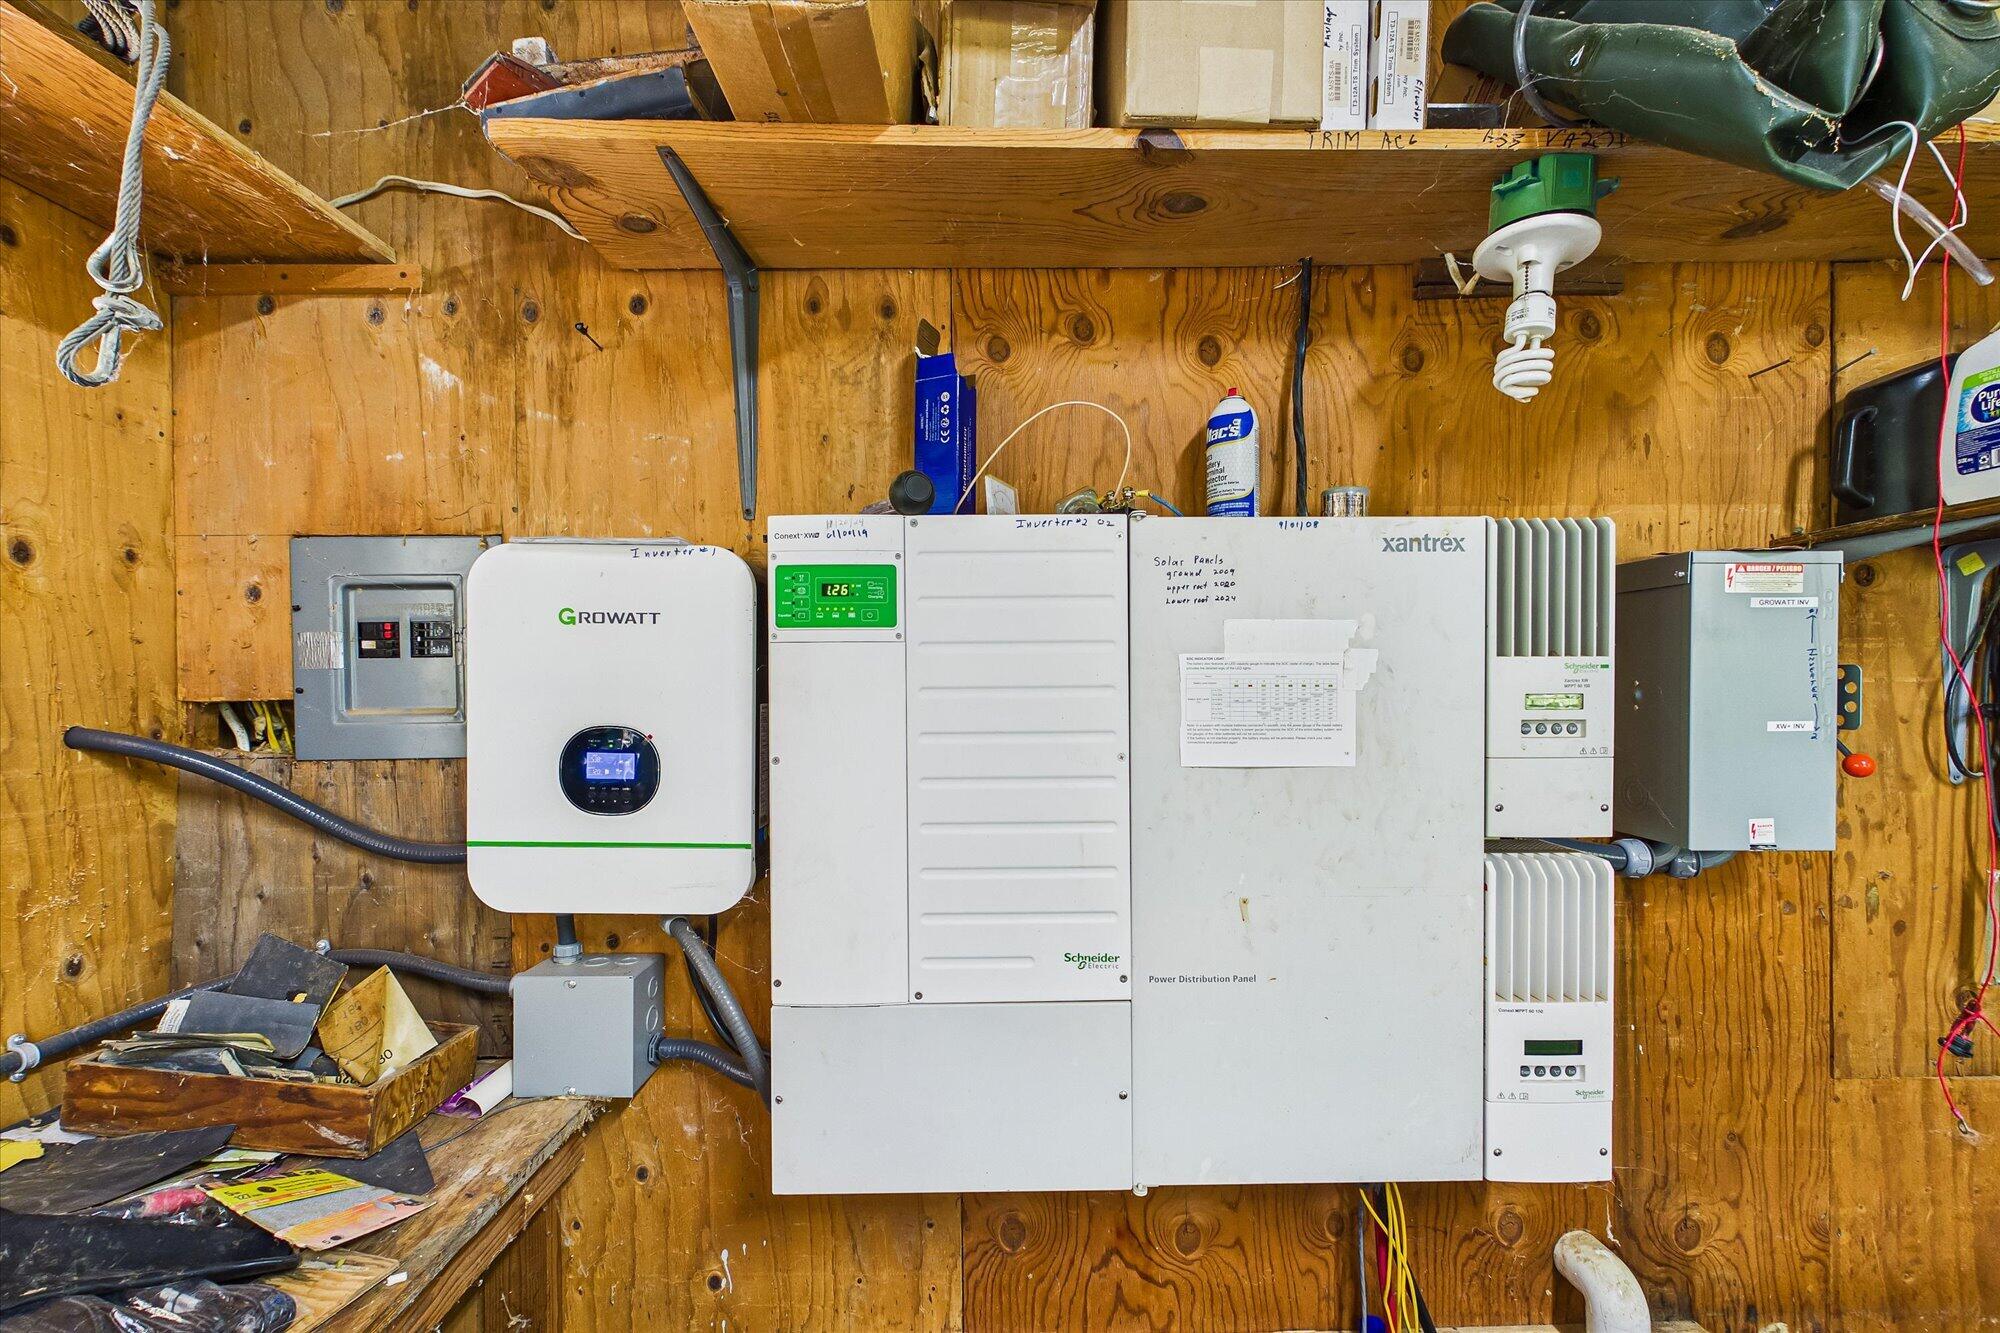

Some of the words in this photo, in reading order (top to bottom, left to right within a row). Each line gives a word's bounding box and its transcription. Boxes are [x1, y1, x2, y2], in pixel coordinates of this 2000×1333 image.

[1388, 19, 1396, 53] T3-12A-TS
[1305, 130, 1360, 150] TRIM
[1979, 388, 2000, 402] Pur
[1016, 518, 1073, 528] Inverter
[1382, 533, 1466, 553] xantrex
[630, 547, 695, 558] Inverter
[1154, 555, 1184, 567] Solar
[1194, 554, 1224, 564] Panels
[1166, 569, 1202, 580] ground
[1167, 584, 1189, 594] upper
[1194, 596, 1209, 604] roof
[558, 607, 661, 626] GROWATT
[1564, 662, 1599, 670] Schneider
[1064, 952, 1120, 962] Schneider
[1148, 975, 1176, 983] Power
[1179, 974, 1231, 983] Distribution
[1232, 974, 1257, 983] Panel
[1575, 1089, 1605, 1097] Schneider
